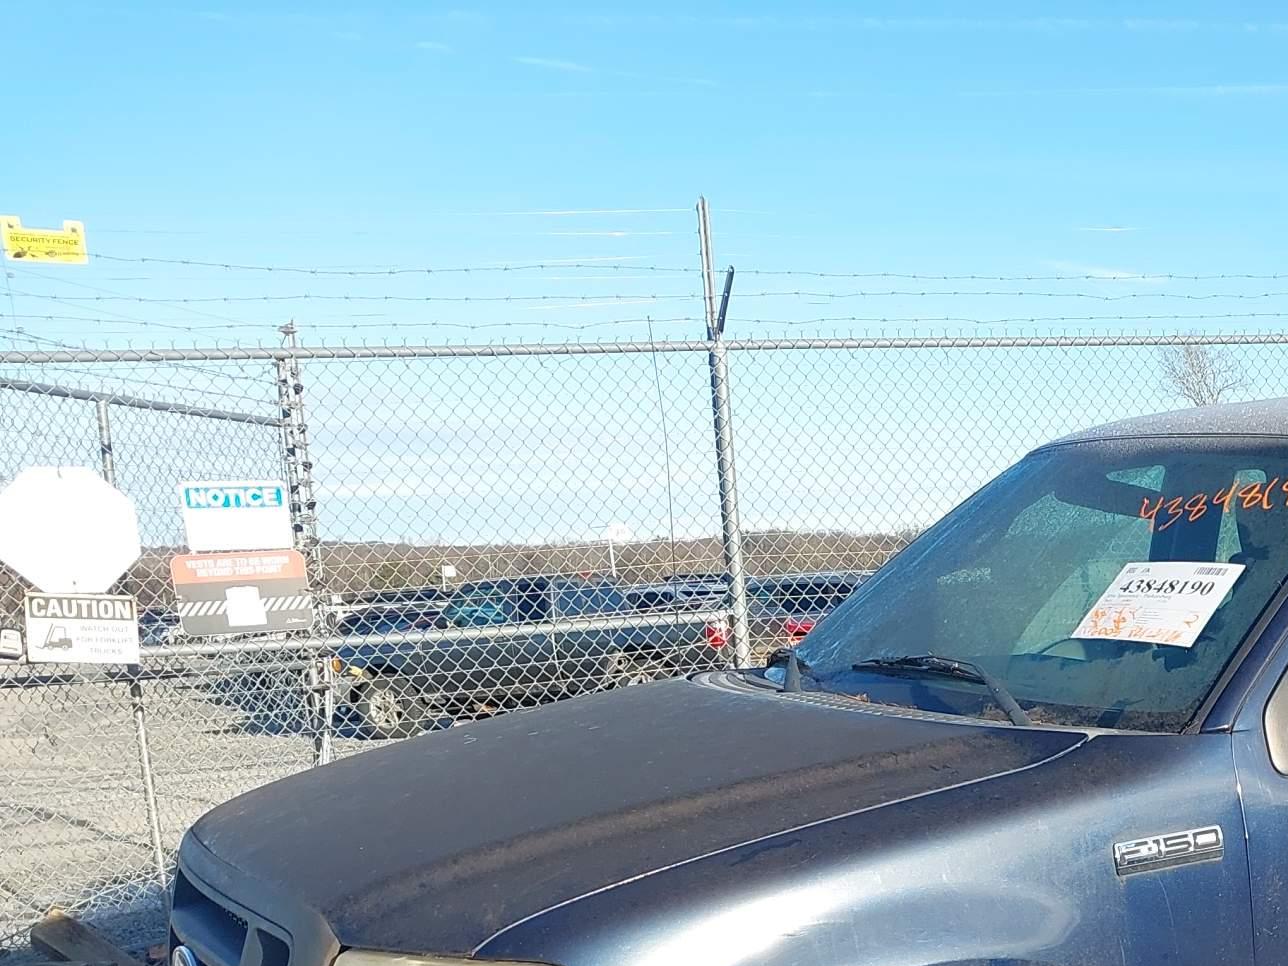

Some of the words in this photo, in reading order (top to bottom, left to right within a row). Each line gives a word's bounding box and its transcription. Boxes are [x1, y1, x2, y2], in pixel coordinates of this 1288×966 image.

[10, 235, 51, 243] SECURITY
[52, 238, 79, 246] FENCE
[188, 487, 278, 507] NOTICE
[1119, 578, 1216, 596] 43848190
[31, 598, 131, 618] CAUTION
[111, 625, 128, 633] OUT
[90, 647, 122, 655] TRUCKS
